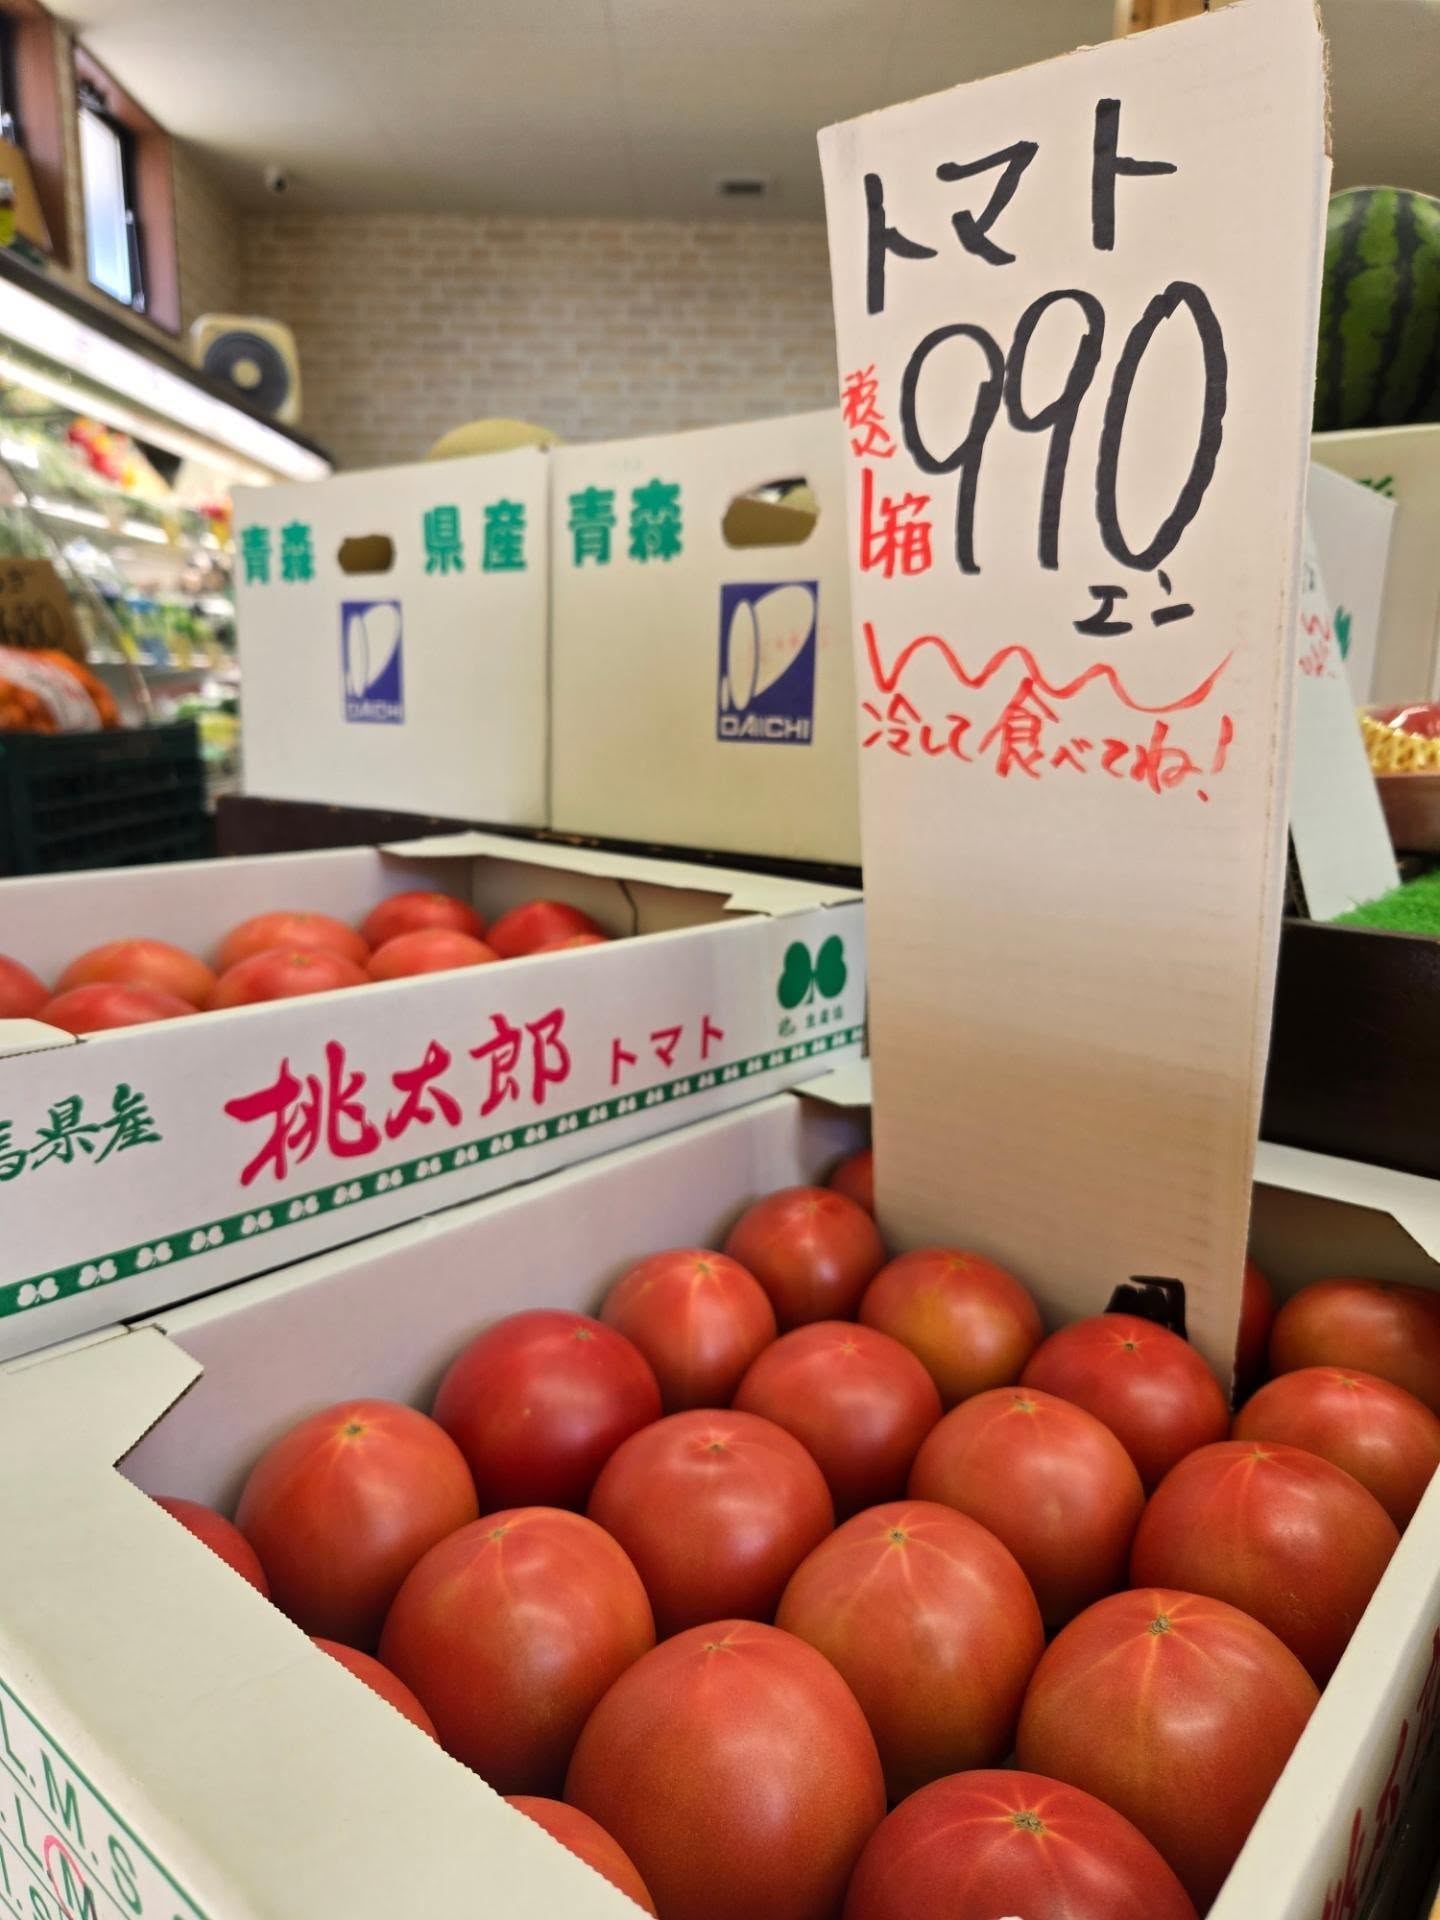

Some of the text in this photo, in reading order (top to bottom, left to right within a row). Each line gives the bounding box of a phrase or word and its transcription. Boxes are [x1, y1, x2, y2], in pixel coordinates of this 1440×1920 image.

[864, 98, 1178, 315] トマト
[900, 281, 1228, 574] 990
[241, 499, 527, 583] 青森 県産
[568, 478, 683, 567] 青森
[1073, 566, 1194, 636] エン
[223, 1007, 725, 1188] 桃太郎 トマト
